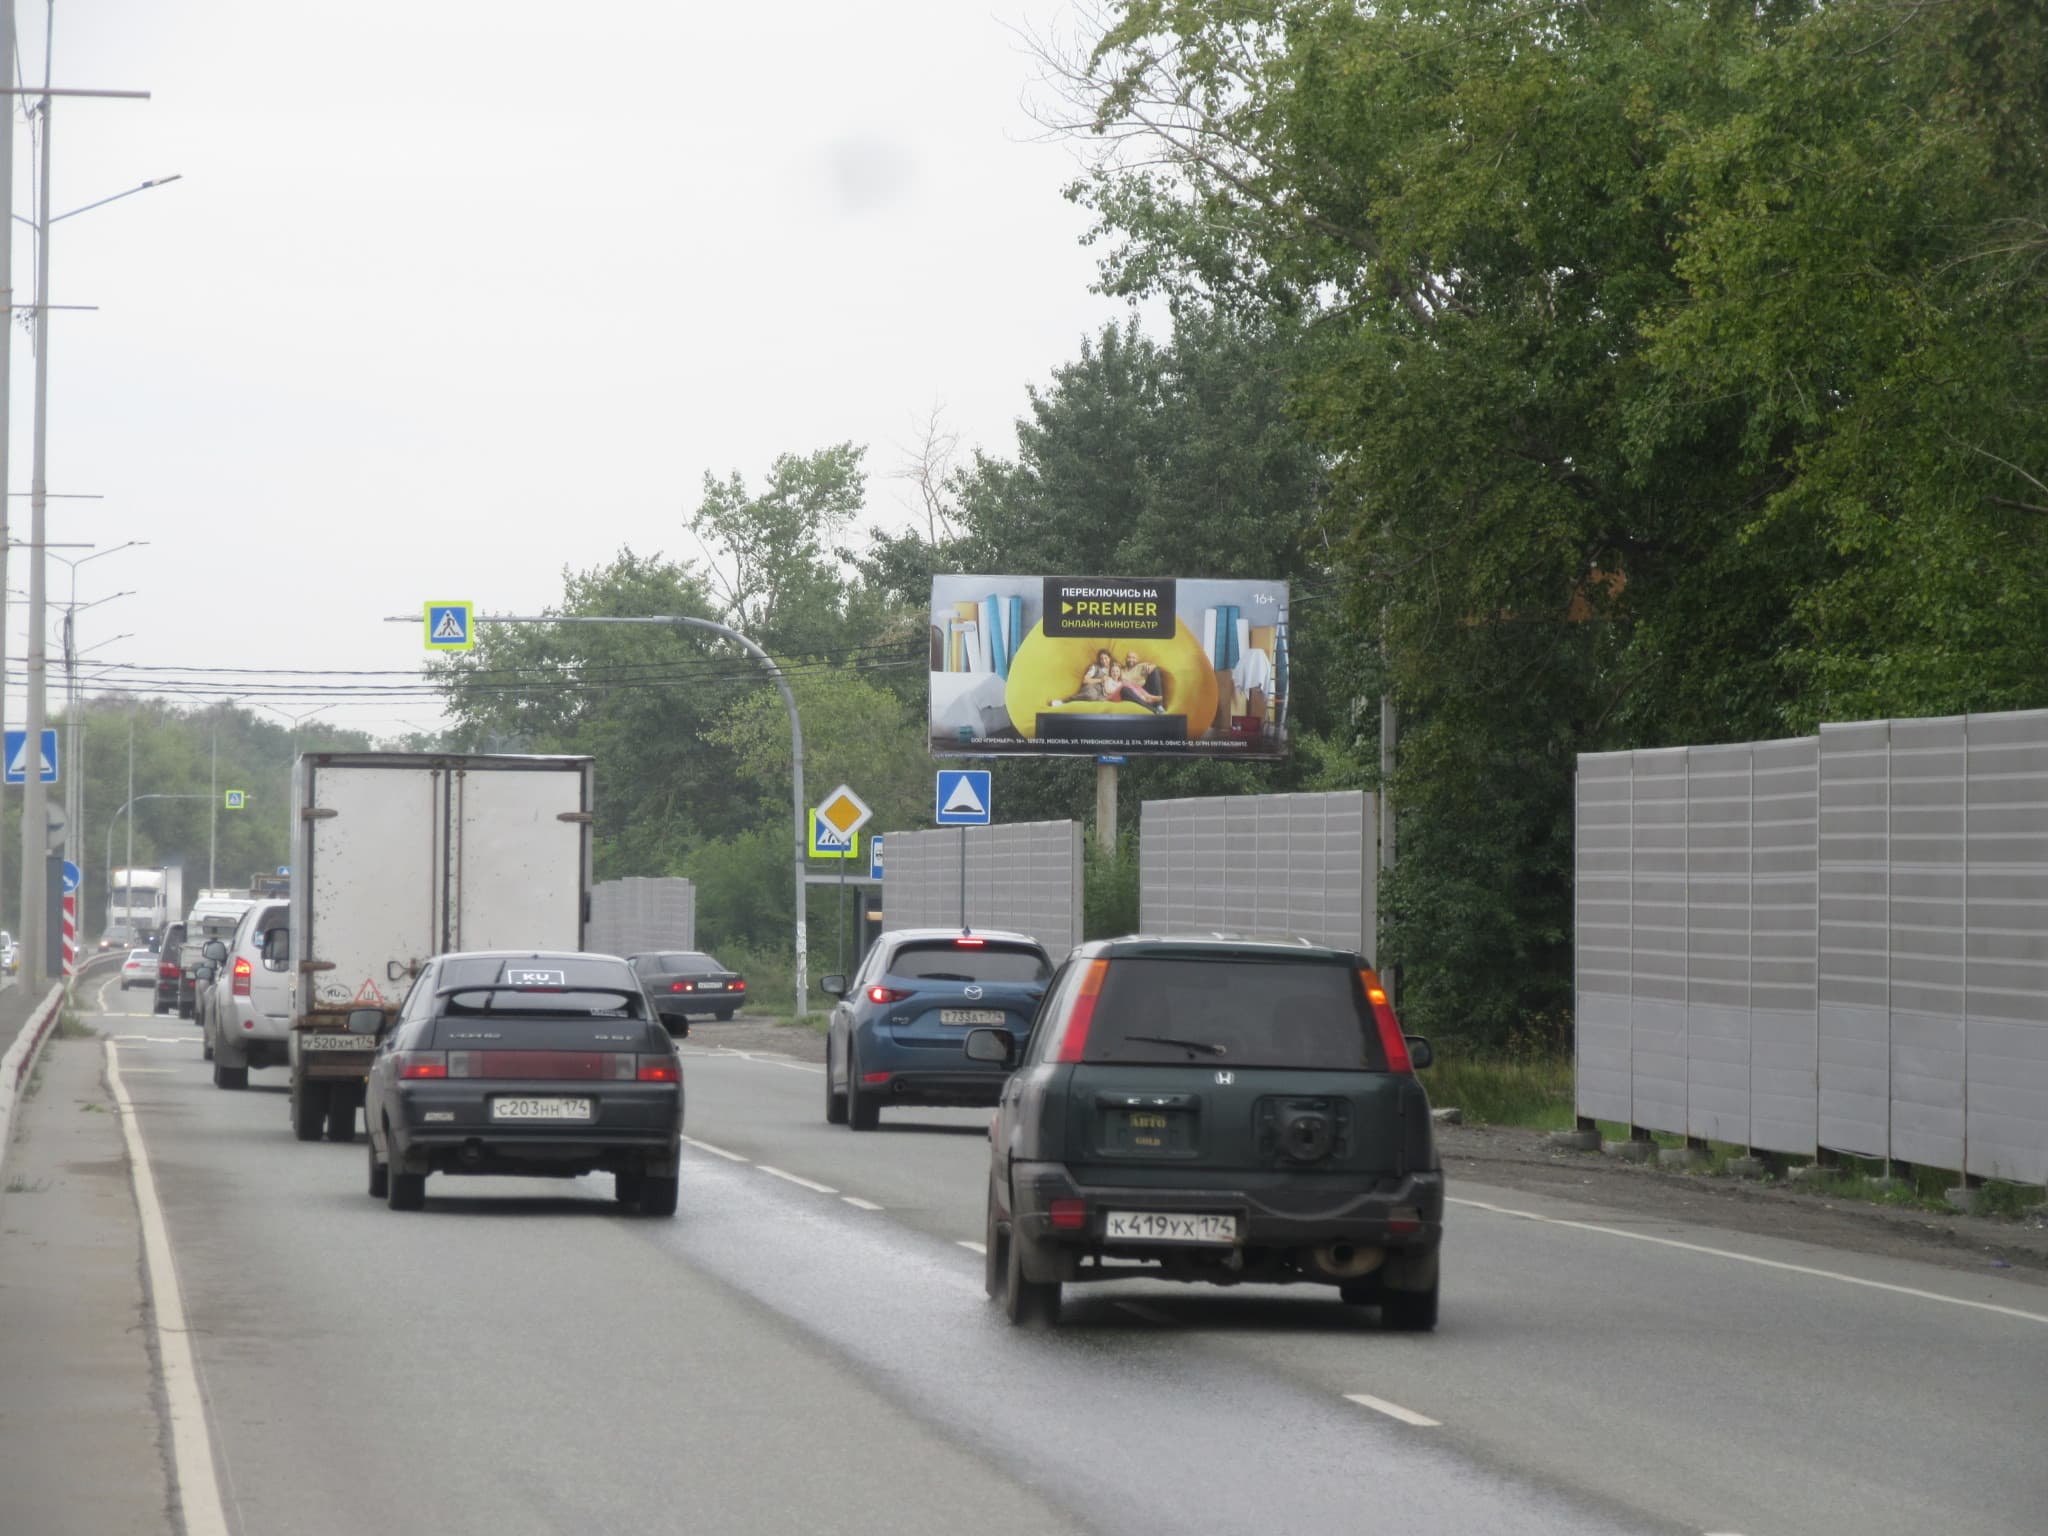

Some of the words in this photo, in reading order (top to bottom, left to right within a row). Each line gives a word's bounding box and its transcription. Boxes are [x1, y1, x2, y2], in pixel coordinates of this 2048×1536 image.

[1061, 588, 1140, 598] ПЕРЕКЛЮЧИСЬ
[1143, 589, 1158, 598] НА
[1253, 593, 1276, 605] 16+
[1077, 601, 1157, 616] PREMIER
[1061, 619, 1158, 629] ОНЛАЙН-КИНОТЕАТР
[522, 973, 549, 981] KU
